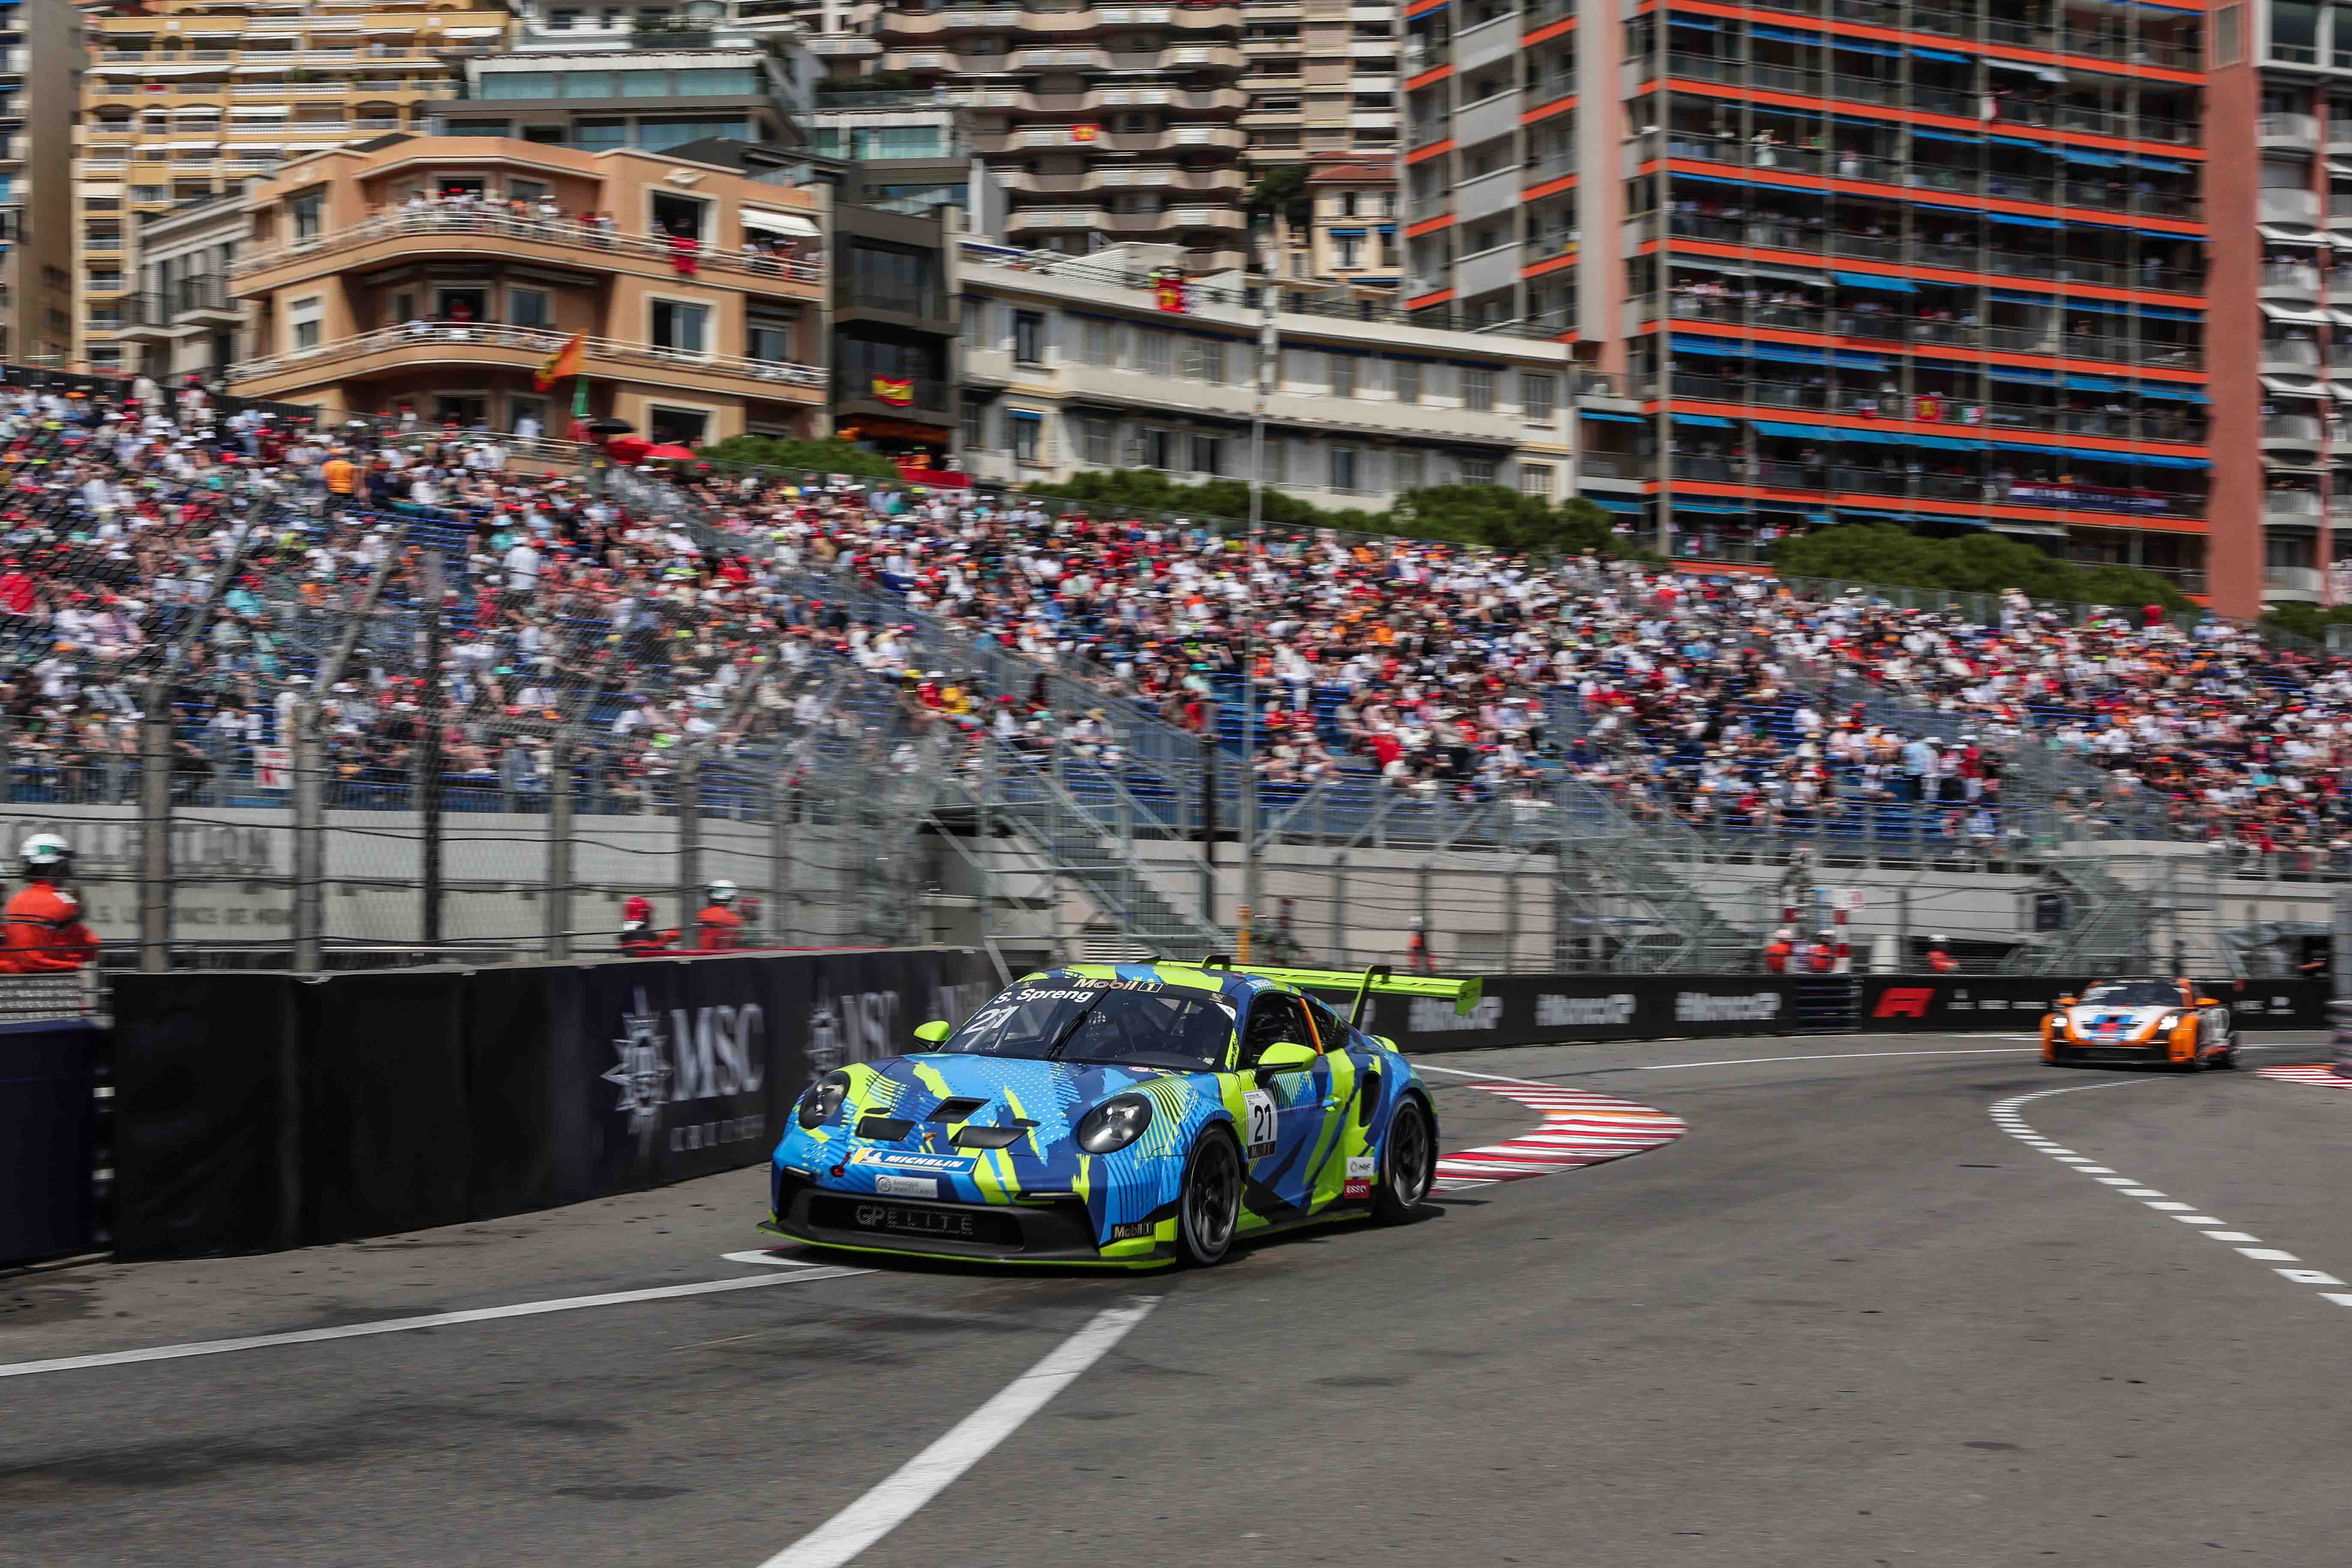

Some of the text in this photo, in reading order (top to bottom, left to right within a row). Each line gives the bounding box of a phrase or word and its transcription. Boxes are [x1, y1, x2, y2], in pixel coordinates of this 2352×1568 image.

[1072, 978, 1138, 991] Mobil
[993, 988, 1095, 1004] S. Spreng
[962, 1005, 1021, 1035] 21
[669, 1003, 764, 1102] MSC
[1254, 1103, 1272, 1143] 21
[884, 1155, 965, 1168] MICHELIN
[1114, 1223, 1143, 1239] Mobil
